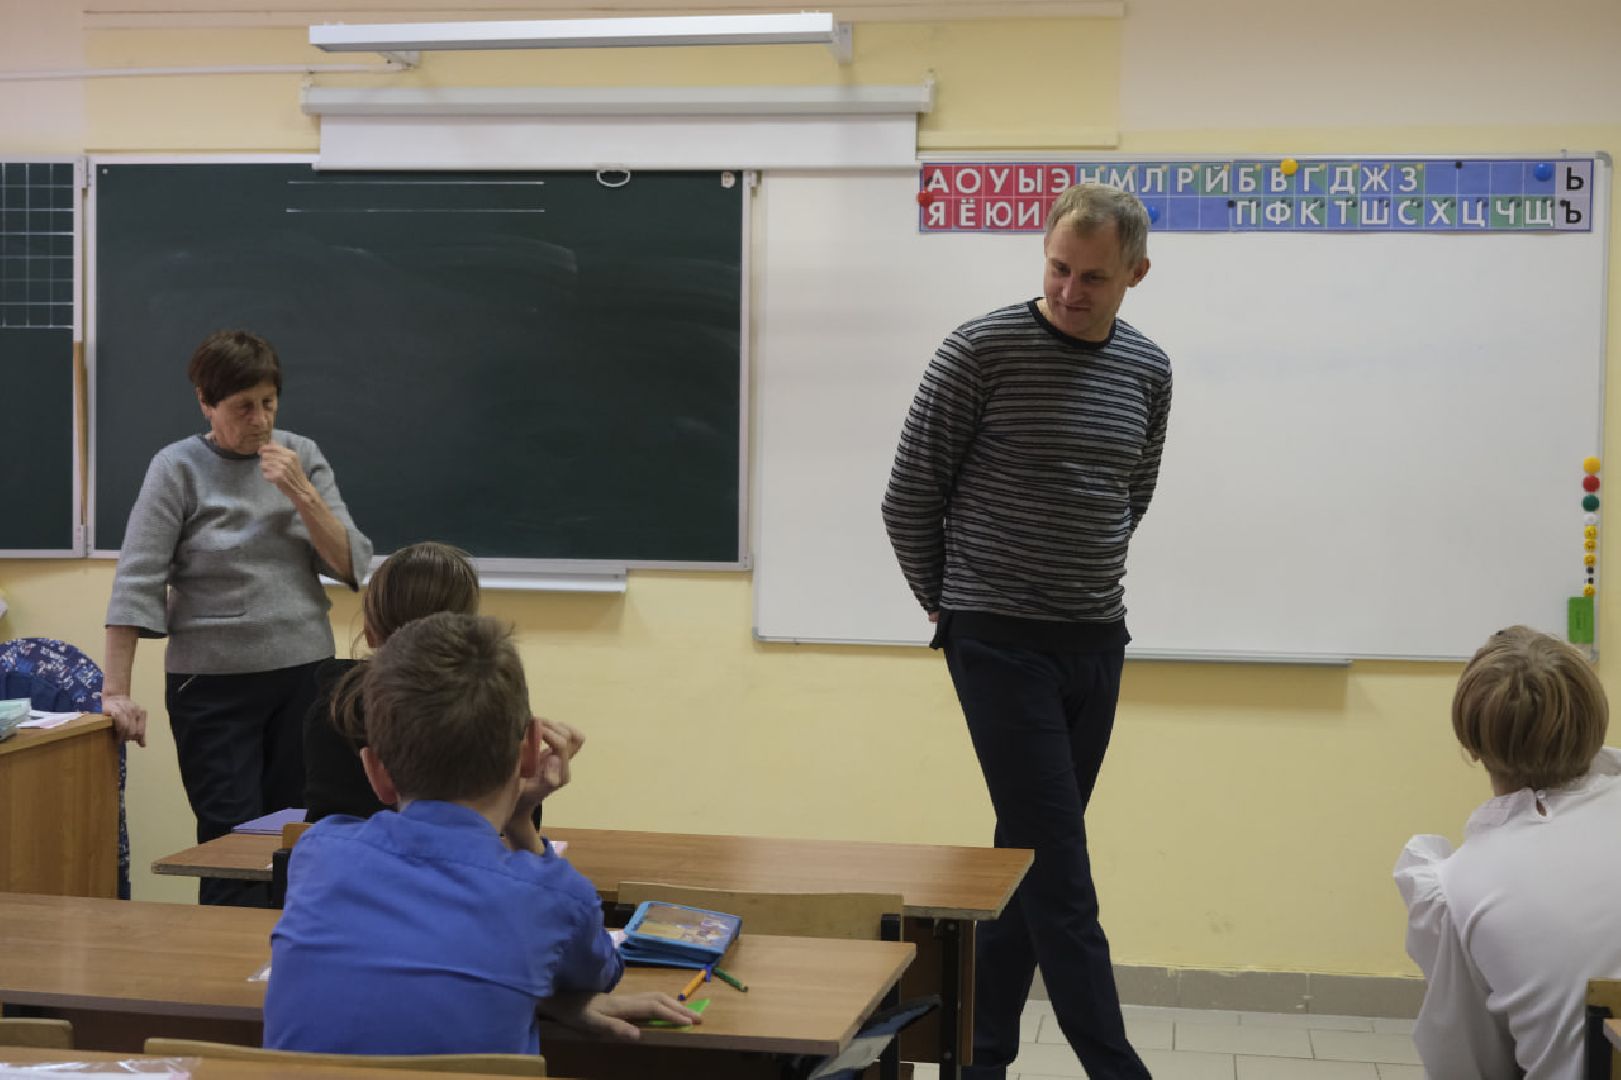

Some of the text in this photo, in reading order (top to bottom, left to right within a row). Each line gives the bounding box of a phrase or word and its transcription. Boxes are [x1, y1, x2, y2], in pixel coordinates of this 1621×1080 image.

[928, 168, 949, 193] А
[956, 168, 981, 193] О
[989, 168, 1010, 193] У
[1018, 168, 1043, 193] Ы
[1051, 168, 1071, 193] Э
[1110, 168, 1135, 193] М
[1142, 168, 1163, 193] Л
[1177, 168, 1194, 193] Р
[1206, 166, 1229, 193] Й
[1238, 167, 1256, 193] Б
[1271, 167, 1288, 193] В
[1304, 167, 1320, 192] Г
[1330, 167, 1355, 195] Д
[1362, 167, 1389, 192] Ж
[1399, 167, 1418, 192] З
[1566, 167, 1584, 191] Ь
[928, 198, 1582, 227] Я Ё Ю И П Ф К Т Ш С Х Ц Ч Щ Ъ
